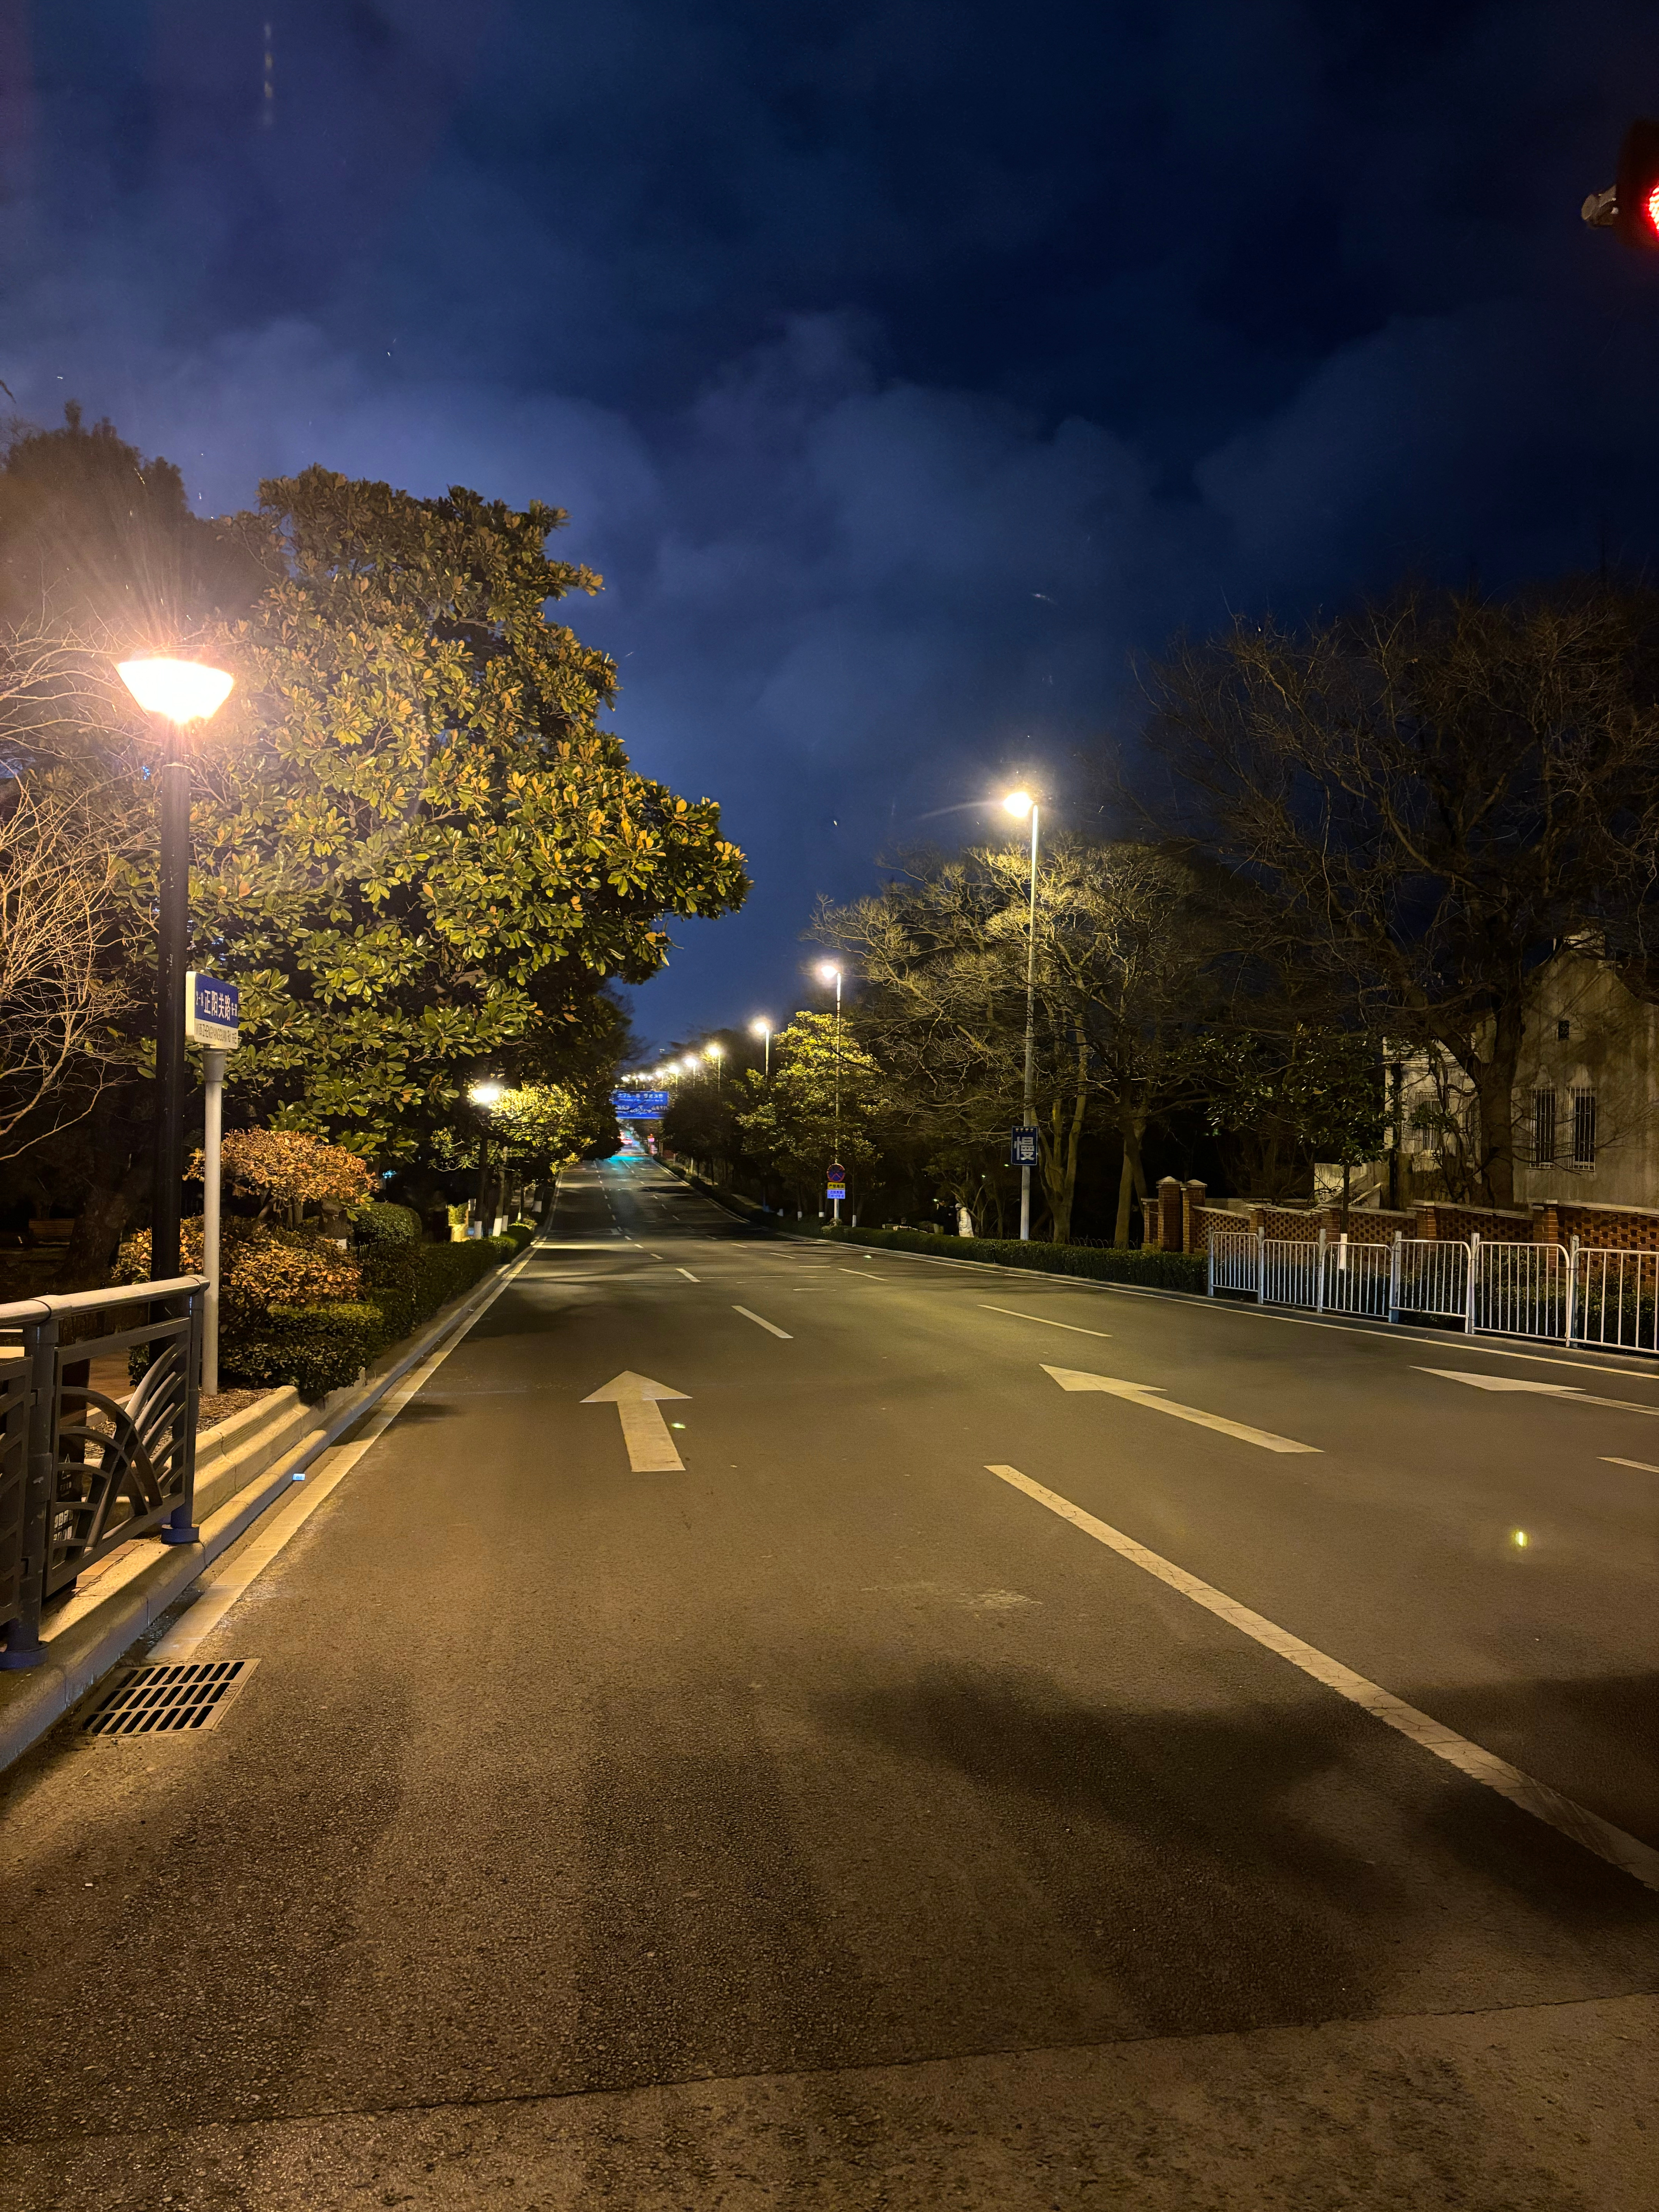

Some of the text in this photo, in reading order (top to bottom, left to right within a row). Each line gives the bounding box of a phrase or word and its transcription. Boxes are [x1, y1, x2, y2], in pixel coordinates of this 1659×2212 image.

[204, 989, 230, 1021] 正阳关路
[1014, 1136, 1035, 1161] 慢
